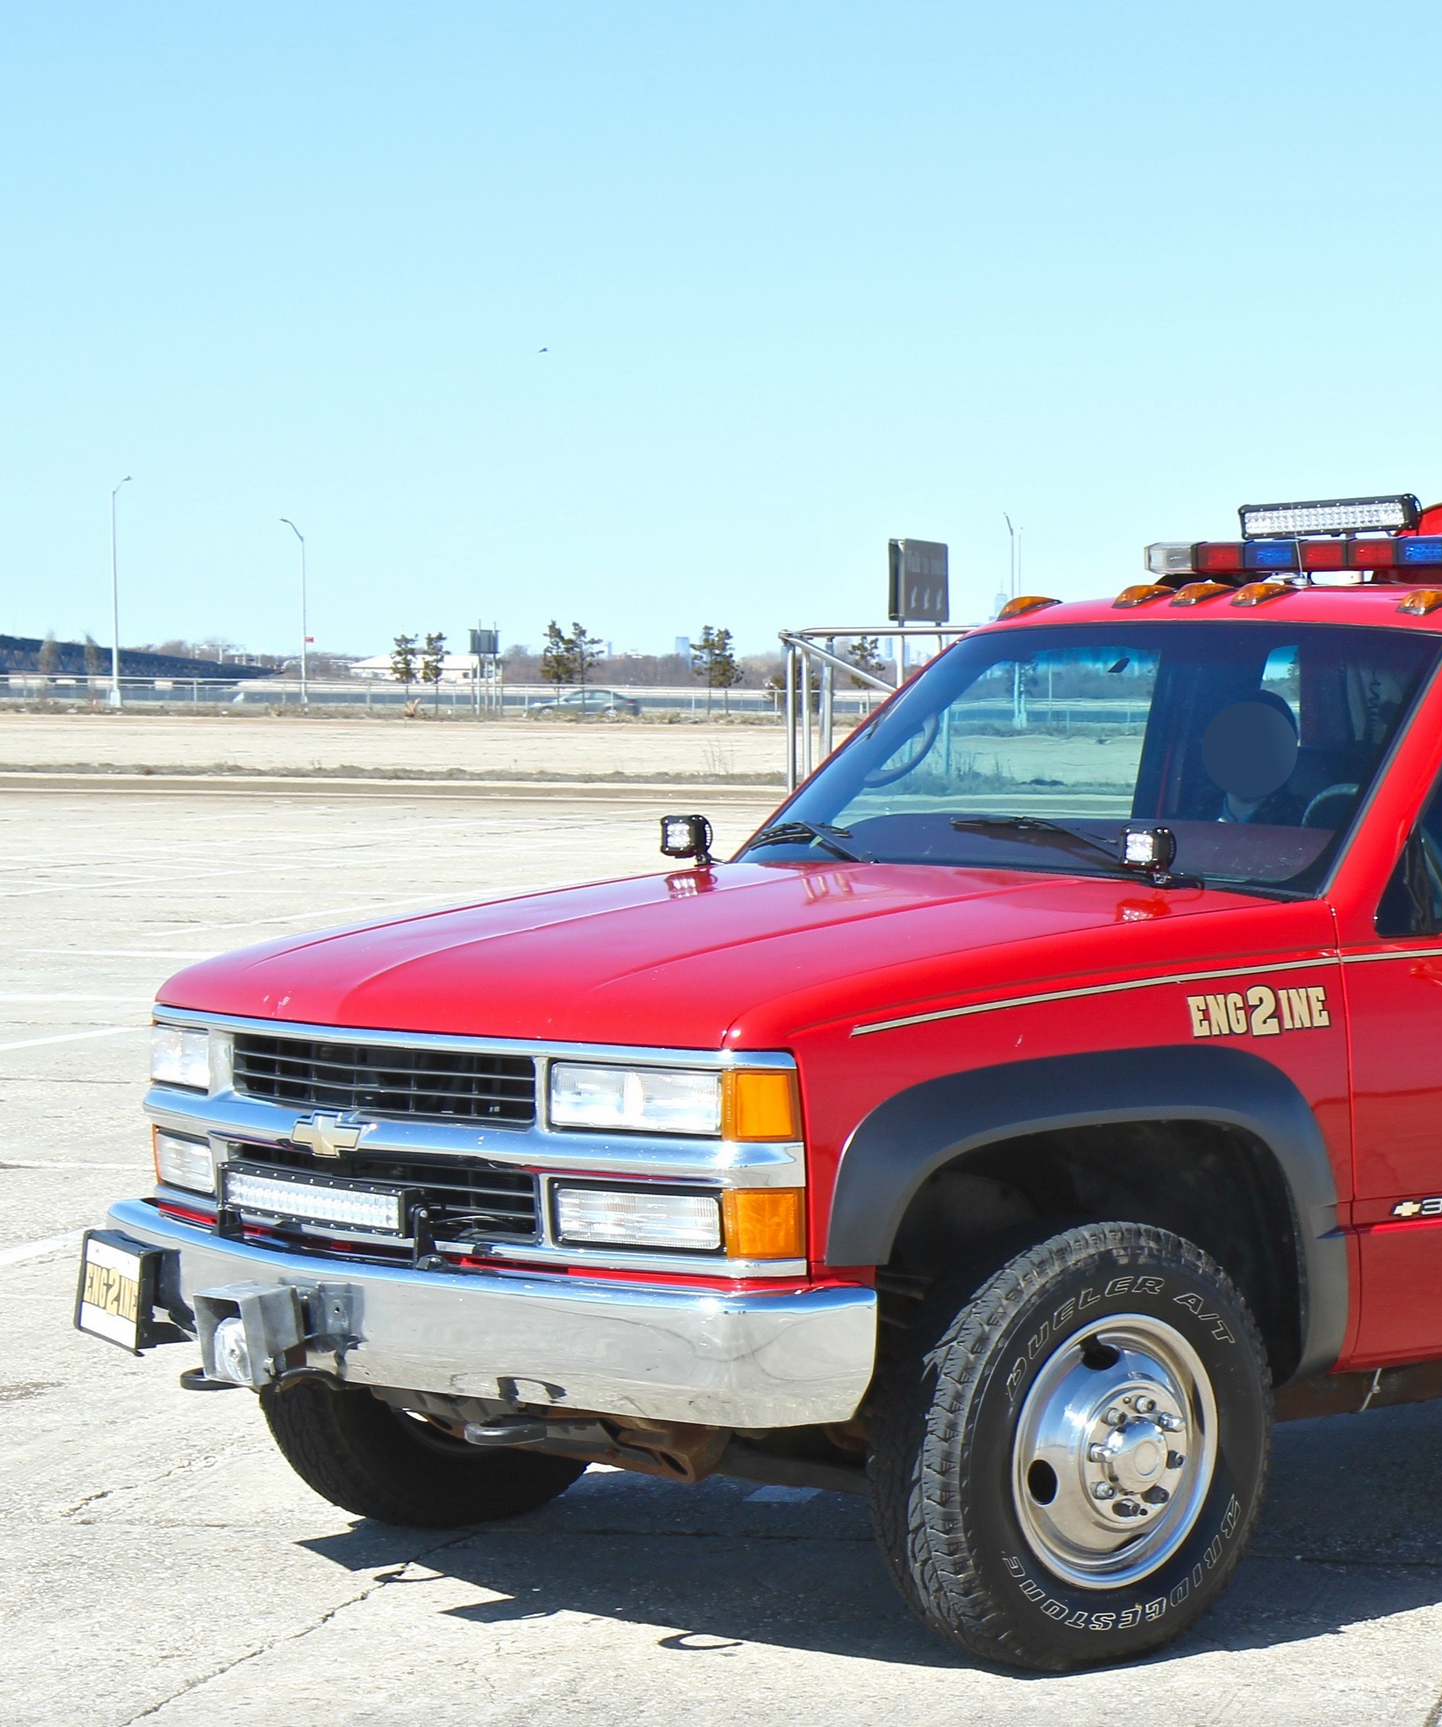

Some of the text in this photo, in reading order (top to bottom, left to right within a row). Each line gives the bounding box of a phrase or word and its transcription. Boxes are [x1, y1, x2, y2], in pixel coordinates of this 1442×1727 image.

[1005, 1275, 1236, 1401] DUELER A/T
[1002, 1493, 1243, 1632] BRIDGESTONE
